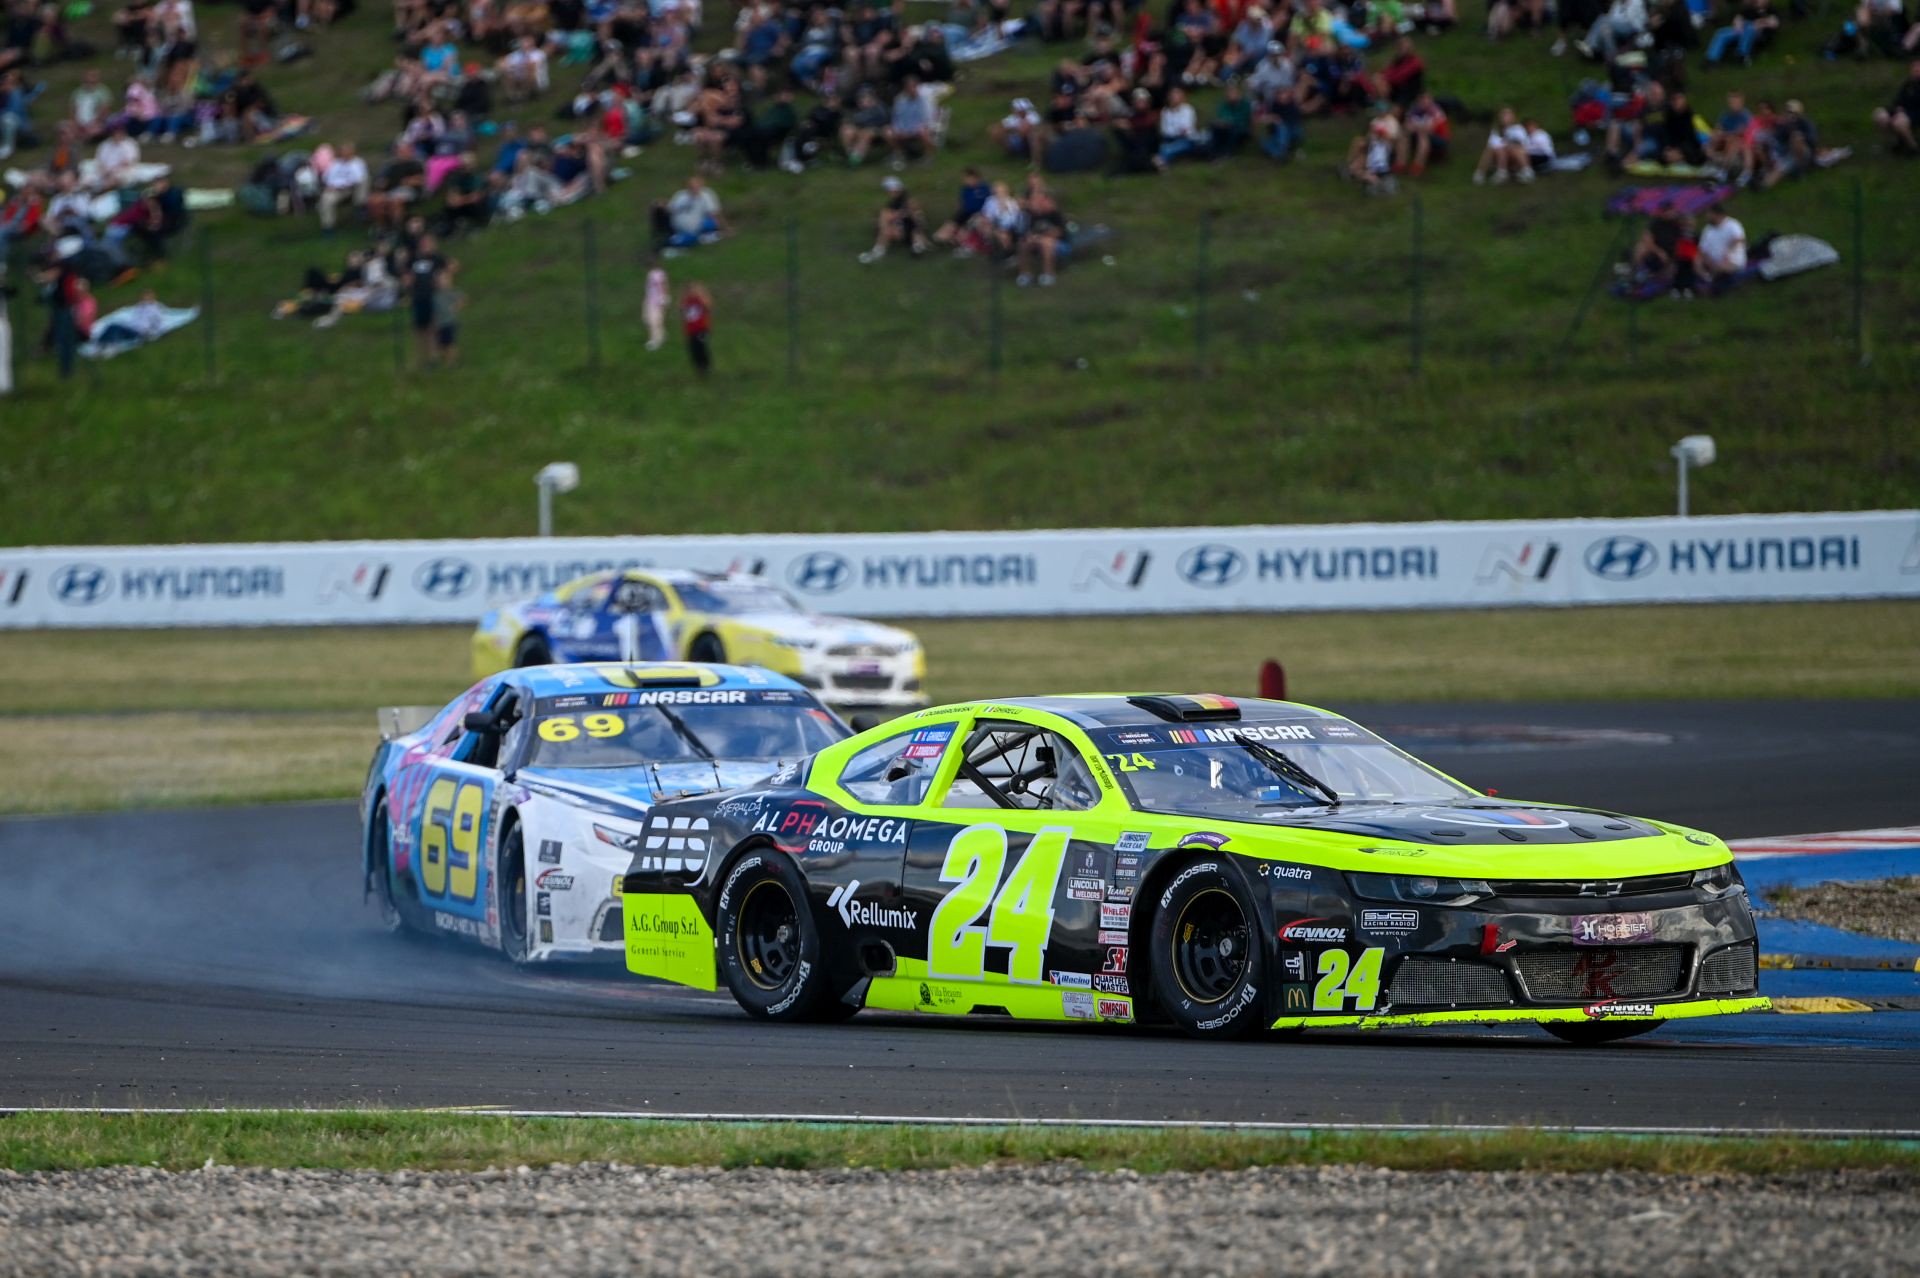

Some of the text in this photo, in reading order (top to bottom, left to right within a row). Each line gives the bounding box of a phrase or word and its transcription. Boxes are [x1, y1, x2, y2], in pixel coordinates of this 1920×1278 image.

[1669, 535, 1861, 573] HYUNDAI
[862, 553, 1037, 588] HYUNDAI
[1256, 545, 1439, 583] HYUNDAI
[121, 565, 284, 599] HYUNDAI
[639, 691, 746, 706] NASCAR
[537, 713, 625, 742] 69
[1204, 725, 1316, 742] NASCAR
[1107, 753, 1156, 772] 24
[752, 811, 907, 844] ALPHAOMEGA
[421, 776, 484, 901] 69
[809, 839, 844, 854] GROUP
[727, 856, 762, 895] HOOSIER
[1168, 863, 1218, 894] HOOSIER
[1273, 866, 1312, 880] quatra
[1070, 880, 1099, 889] LINCOLN
[927, 822, 1073, 986] 24
[1075, 890, 1100, 899] WELDERS
[850, 900, 917, 930] Rellumix
[1102, 905, 1129, 916] WHELEN
[631, 913, 651, 932] A.G.
[653, 915, 679, 939] Group
[1283, 927, 1346, 939] KENNOL
[631, 944, 686, 959] General Service
[1062, 974, 1090, 985] iRacing
[1094, 975, 1126, 986] QUARTER
[1101, 982, 1128, 993] MASTER
[1313, 947, 1385, 1011] 24
[1100, 1001, 1128, 1017] SIMPSON
[1197, 1001, 1247, 1030] HOOSIER
[1589, 1004, 1653, 1013] KENNOL
